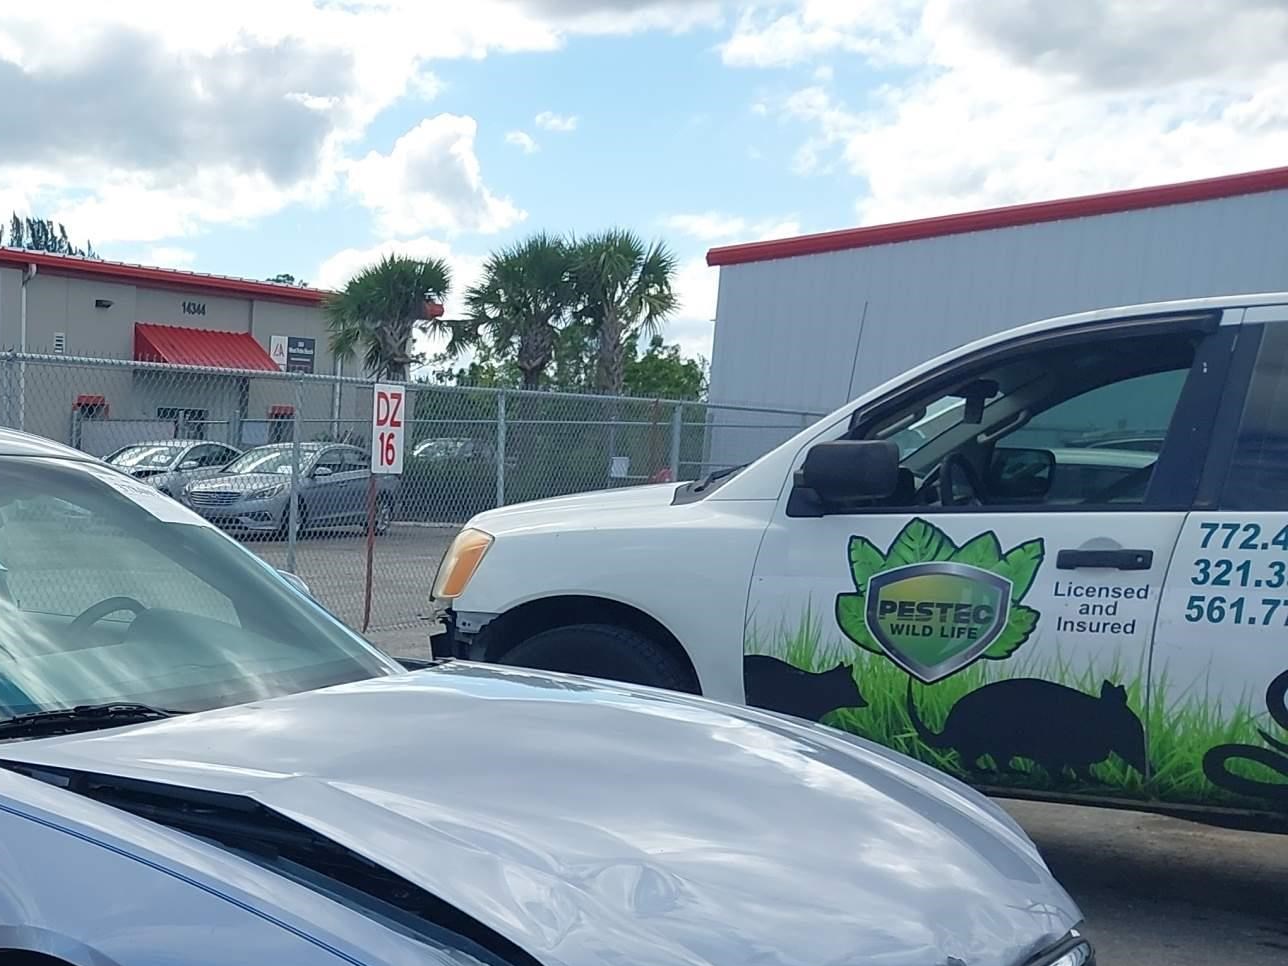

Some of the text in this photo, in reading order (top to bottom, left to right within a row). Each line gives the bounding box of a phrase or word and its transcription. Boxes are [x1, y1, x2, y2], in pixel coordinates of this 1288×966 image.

[182, 301, 206, 316] 14344
[376, 391, 402, 427] DZ
[379, 432, 395, 466] 16
[1191, 559, 1288, 588] 321.3
[1054, 581, 1149, 600] Licensed
[879, 600, 993, 624] PESTEC
[1078, 600, 1118, 616] and
[890, 623, 977, 639] WILD LIFE
[1056, 616, 1136, 635] Insured
